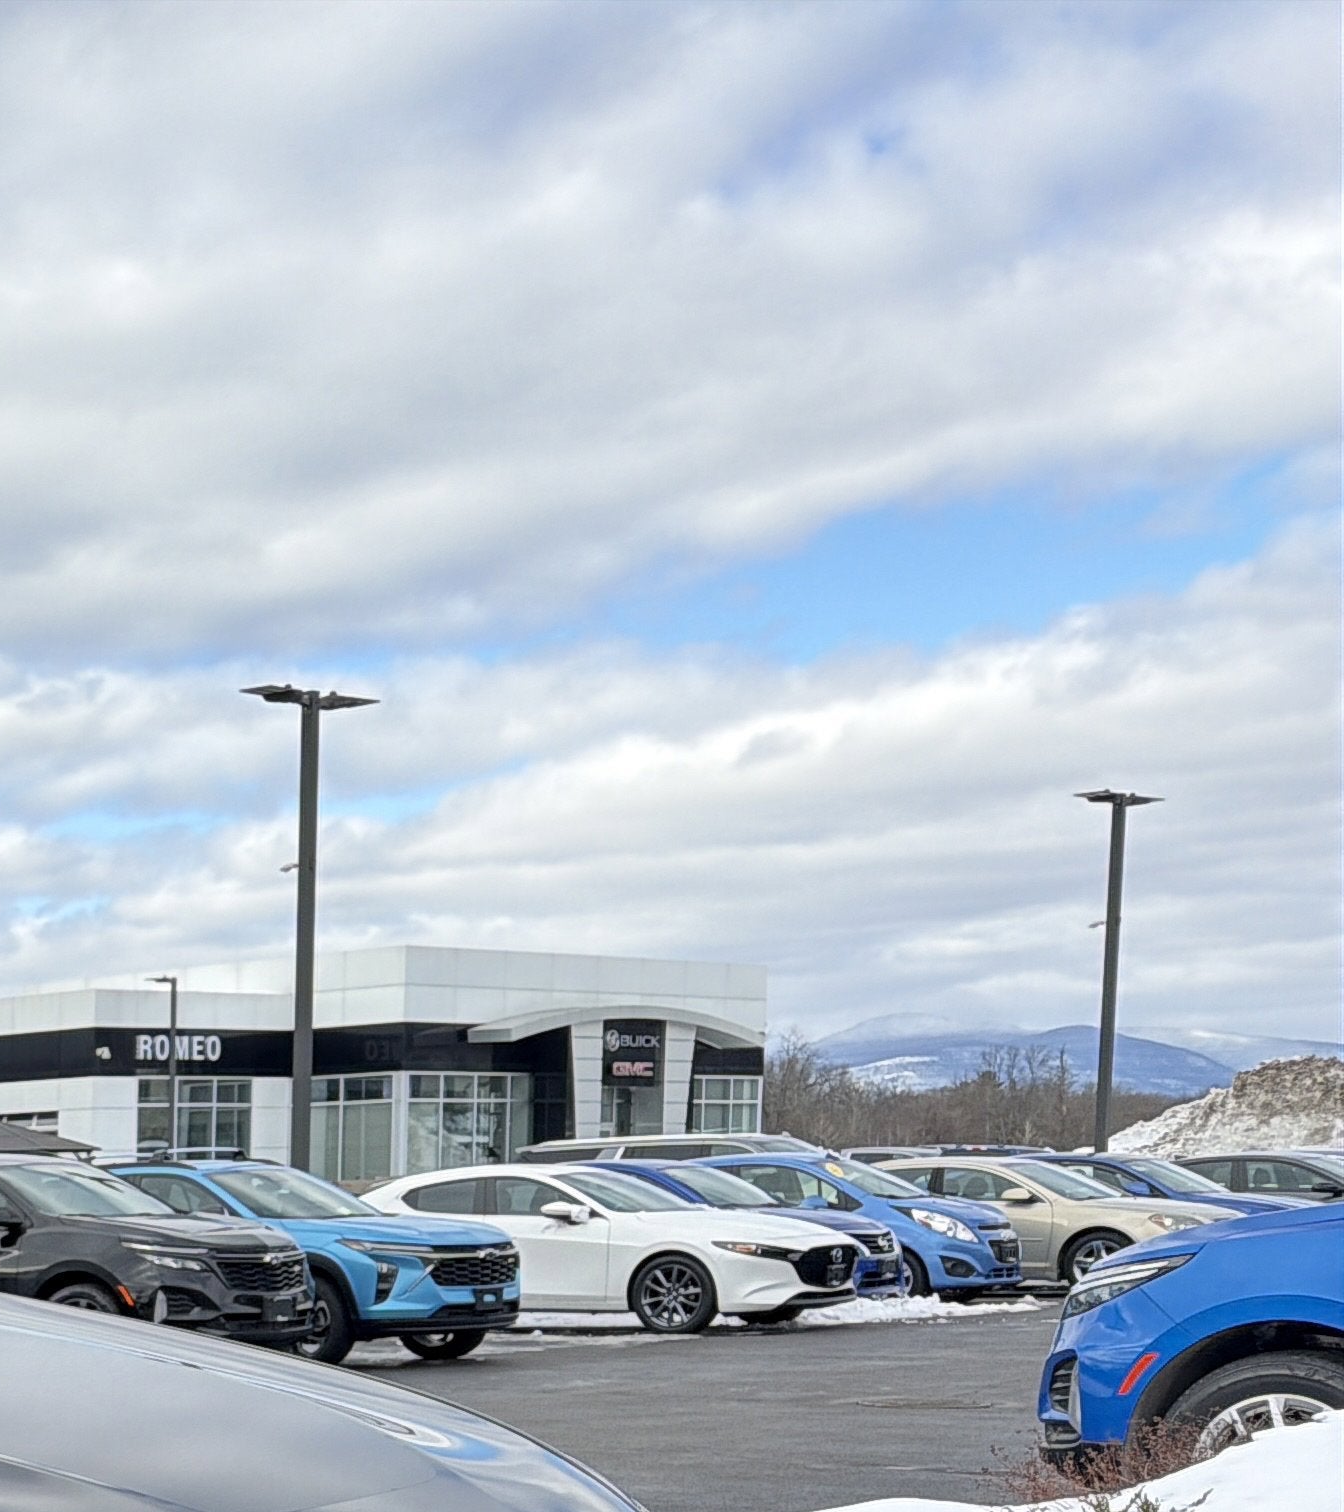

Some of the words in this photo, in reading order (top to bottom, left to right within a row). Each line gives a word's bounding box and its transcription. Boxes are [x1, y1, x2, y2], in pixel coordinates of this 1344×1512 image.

[135, 1034, 222, 1062] ROMEO
[620, 1034, 661, 1048] BUICK
[612, 1061, 654, 1077] GMC
